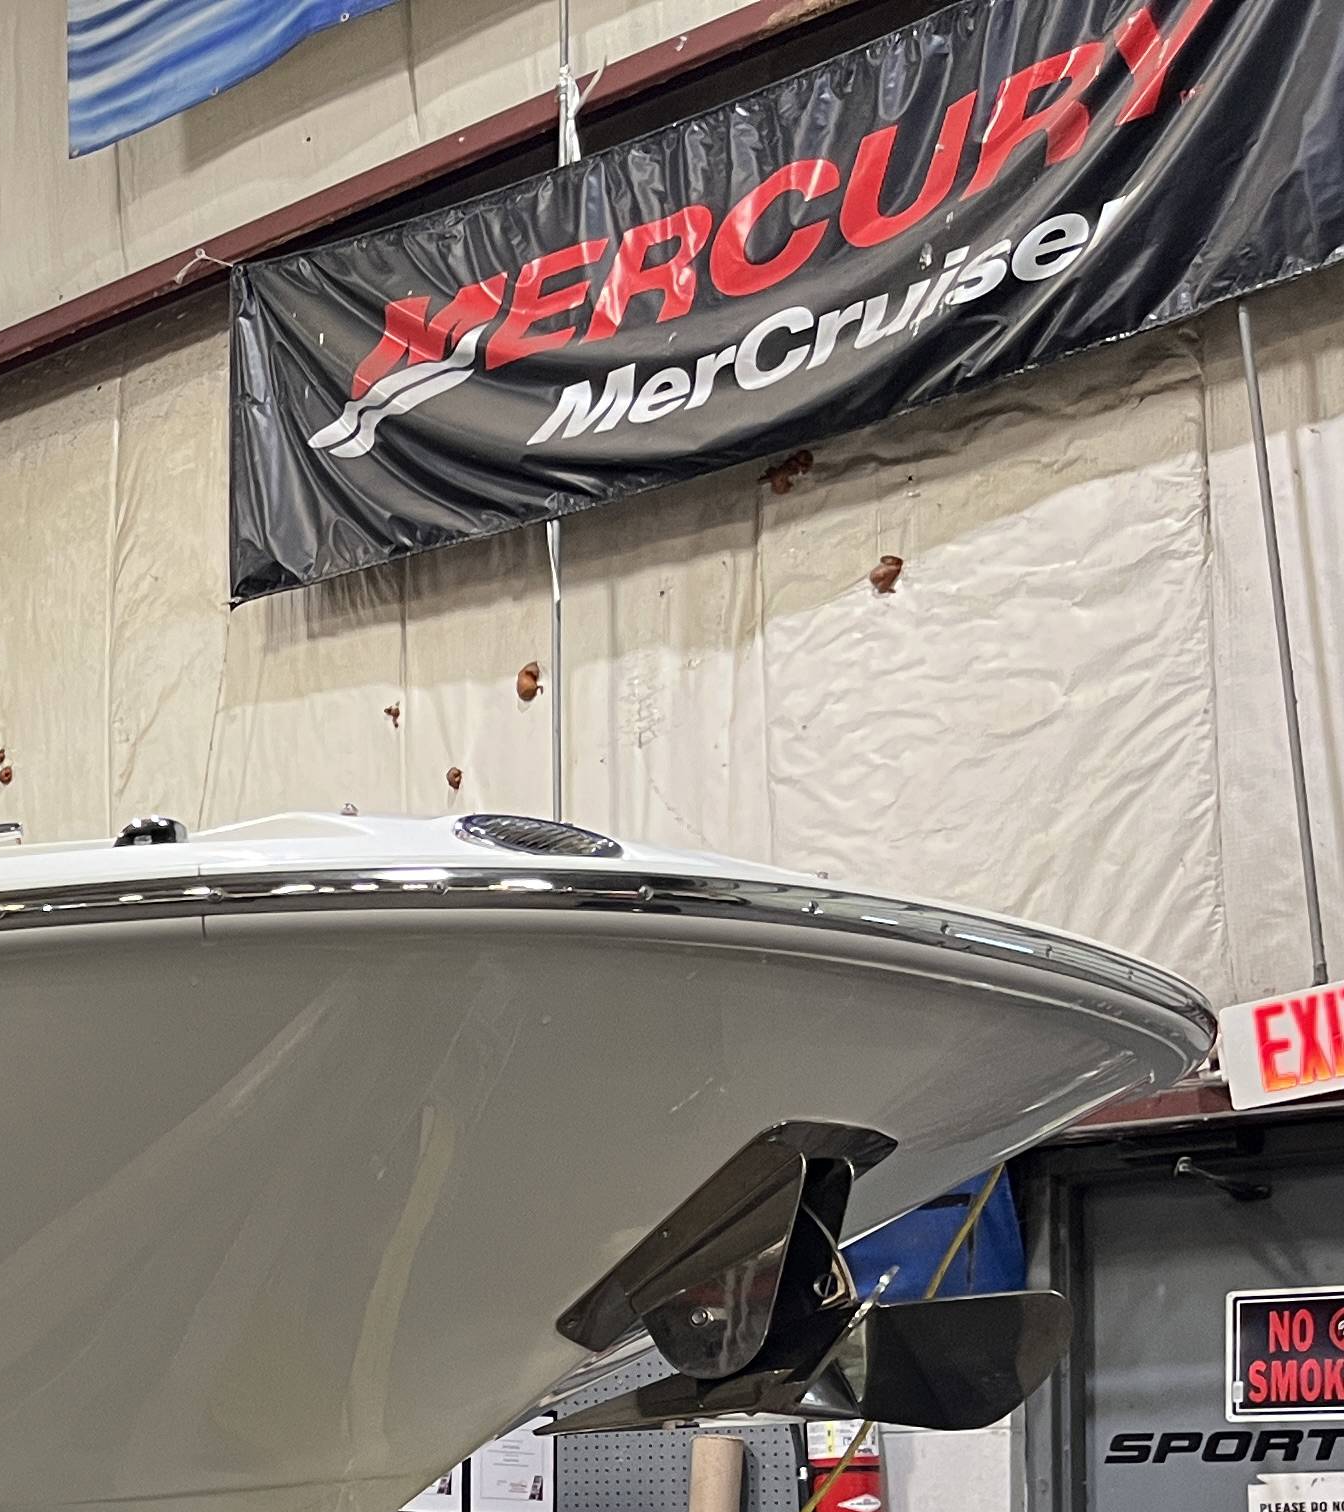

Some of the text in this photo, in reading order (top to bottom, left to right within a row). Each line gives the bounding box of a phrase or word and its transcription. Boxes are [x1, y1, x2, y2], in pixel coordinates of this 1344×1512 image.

[352, 0, 1211, 400] MERCURY
[526, 180, 1140, 446] MerCruiser
[1253, 986, 1344, 1092] EXI
[1268, 1308, 1315, 1354] NO
[1104, 1429, 1344, 1464] SPORT
[1311, 1501, 1328, 1512] DO
